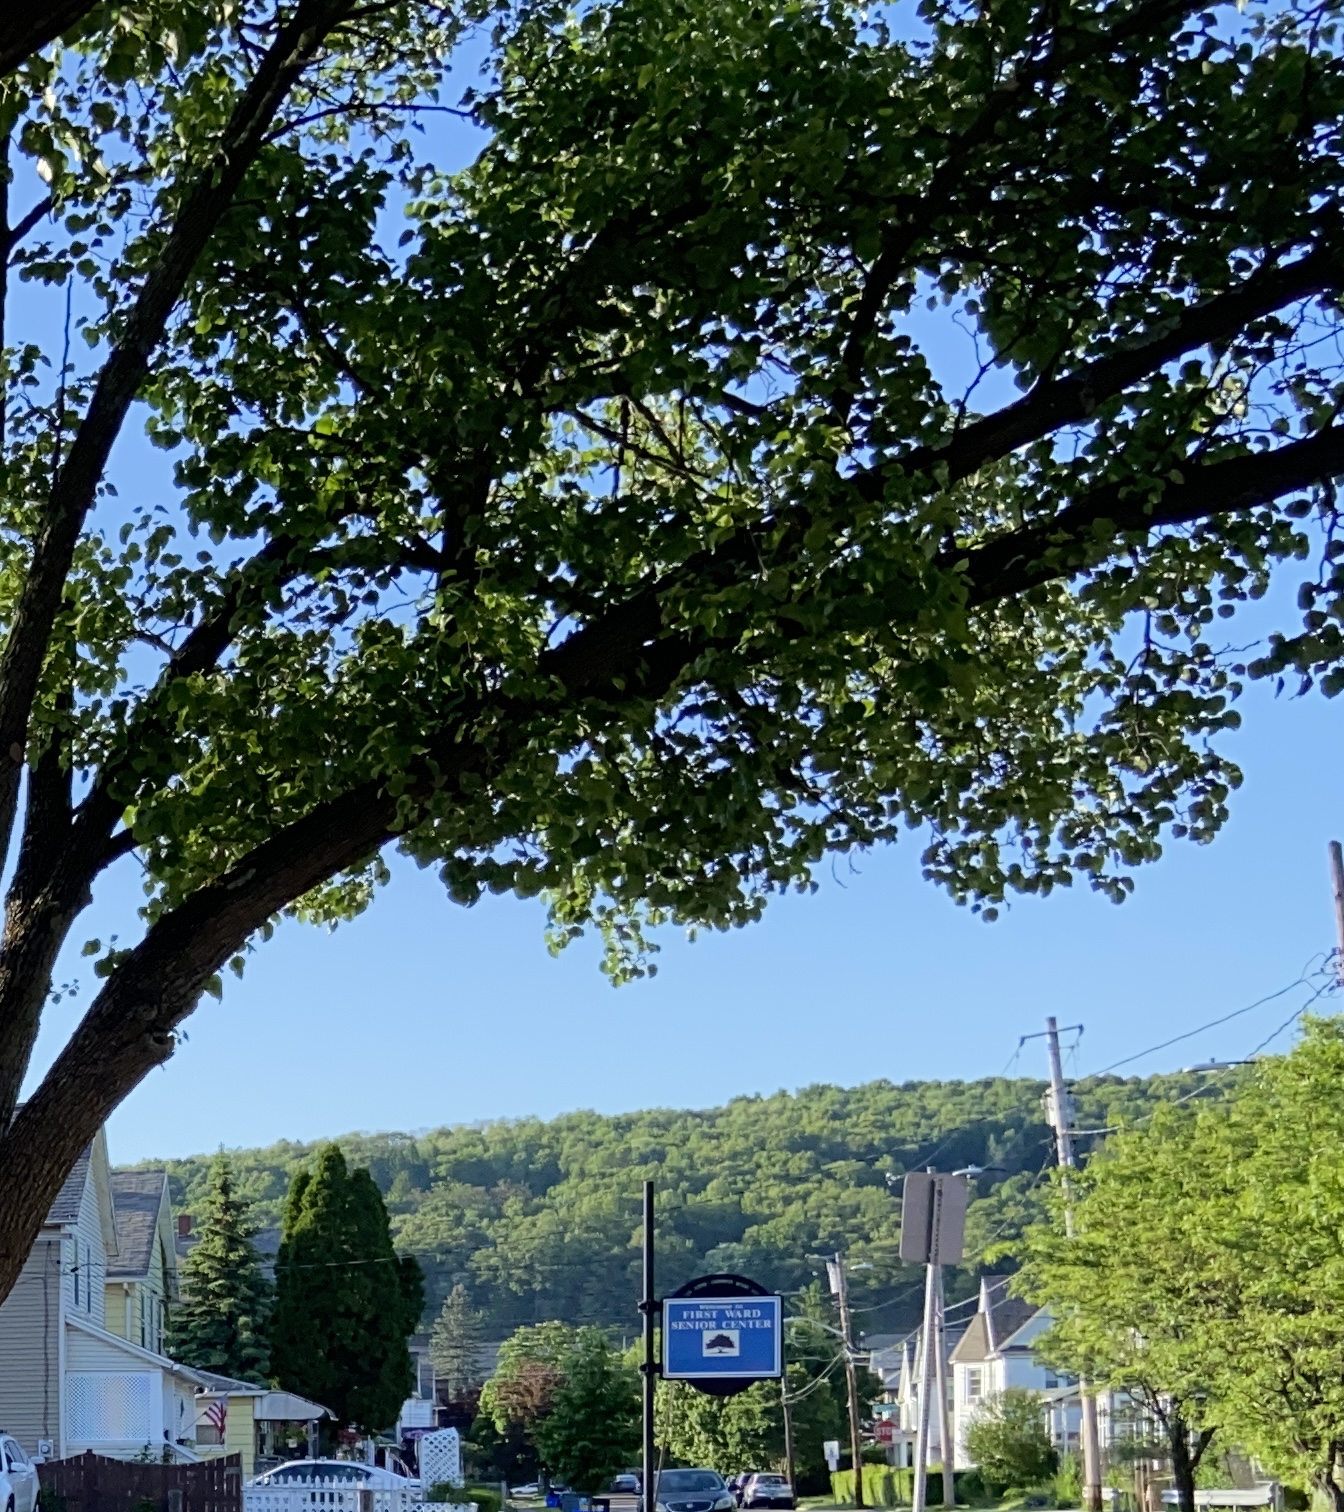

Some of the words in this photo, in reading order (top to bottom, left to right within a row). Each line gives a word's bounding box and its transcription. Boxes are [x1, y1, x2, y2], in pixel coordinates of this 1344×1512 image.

[682, 1310, 718, 1319] FIRST
[725, 1309, 761, 1318] WARD
[671, 1321, 717, 1330] SENIOR
[722, 1319, 772, 1329] CENTER
